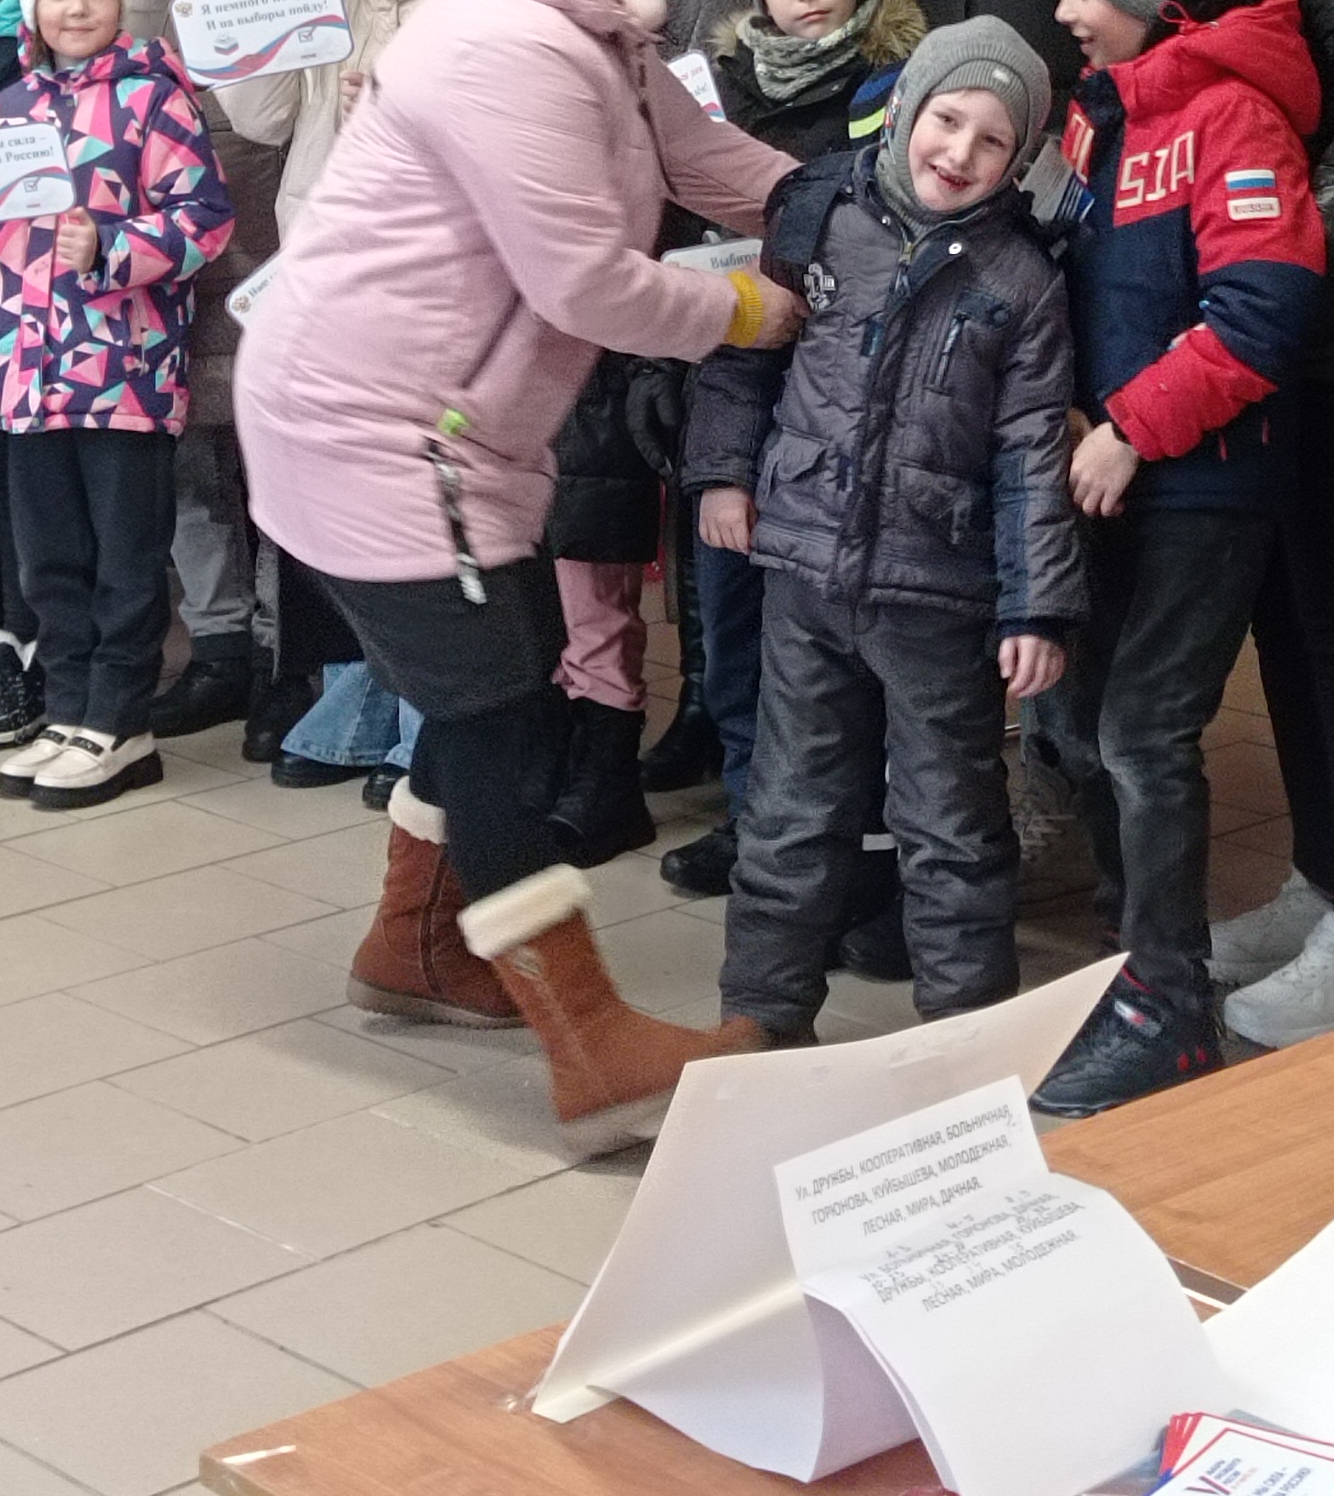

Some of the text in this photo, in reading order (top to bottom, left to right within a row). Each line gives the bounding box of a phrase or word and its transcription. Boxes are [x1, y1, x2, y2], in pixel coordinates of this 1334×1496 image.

[201, 5, 211, 15] Я
[206, 20, 217, 31] И
[220, 18, 234, 29] на
[237, 11, 285, 27] выборы
[8, 135, 36, 147] сила
[6, 146, 54, 163] Россию!
[813, 1166, 858, 1195] ДРУЖБЫ,
[859, 1131, 945, 1175] КООПЕРАТИВНАЯ,
[946, 1105, 1013, 1141] БОЛЬНИЧНАЯ,
[812, 1192, 872, 1224] ГОРЮНОВА,
[872, 1165, 938, 1199] КУЙБЫШЕВА,
[863, 1208, 906, 1236] ЛЕСНАЯ,
[906, 1195, 940, 1216] МИРА,
[940, 1176, 983, 1205] ДАЧНАЯ.
